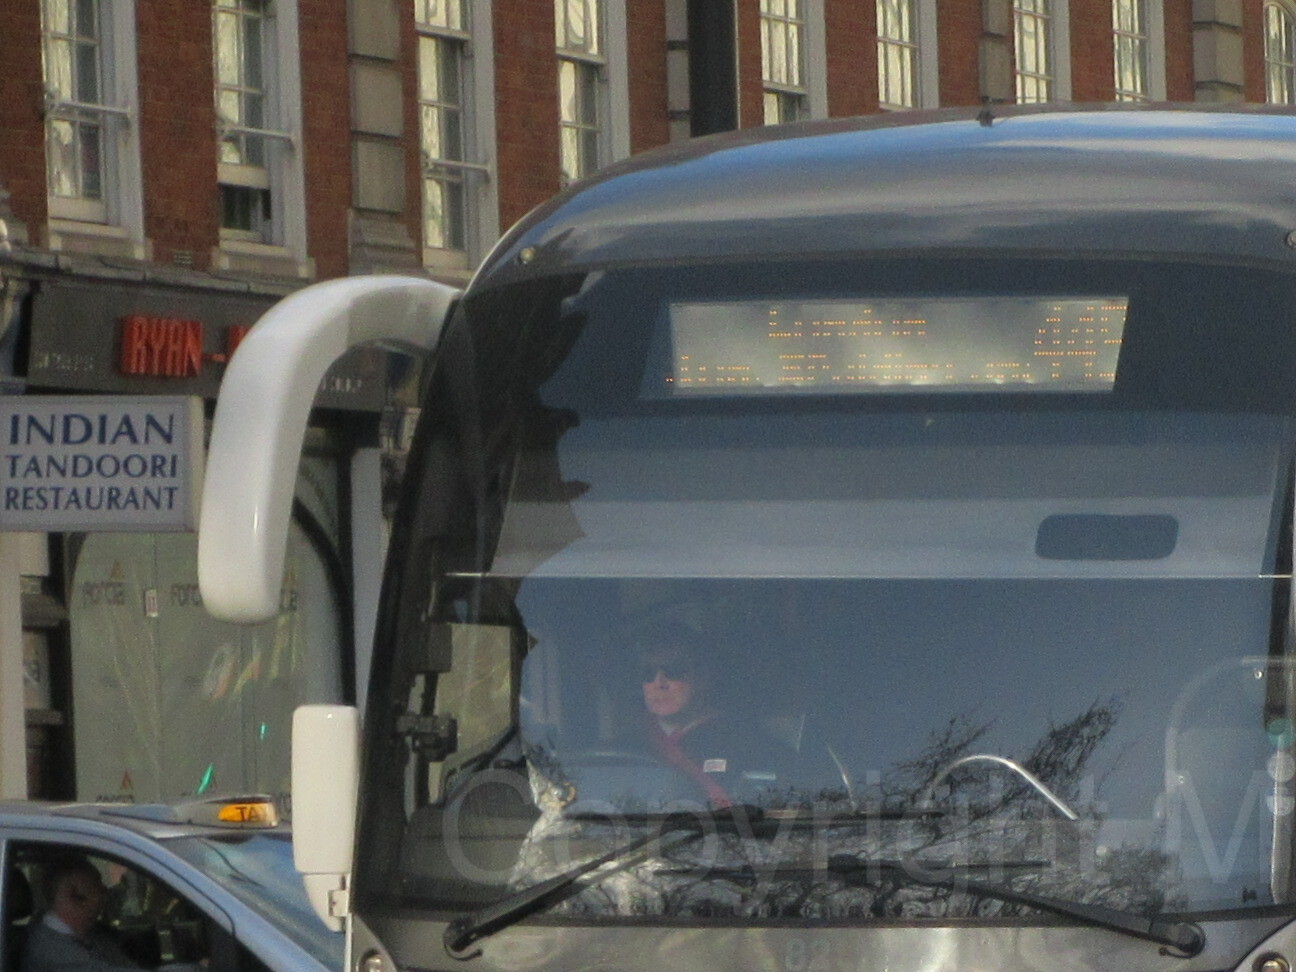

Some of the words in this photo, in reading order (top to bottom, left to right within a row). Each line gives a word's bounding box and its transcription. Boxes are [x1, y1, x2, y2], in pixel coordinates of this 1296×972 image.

[9, 413, 174, 445] INDIAN
[6, 454, 178, 478] TANDOORI
[5, 486, 178, 511] RESTAURANT
